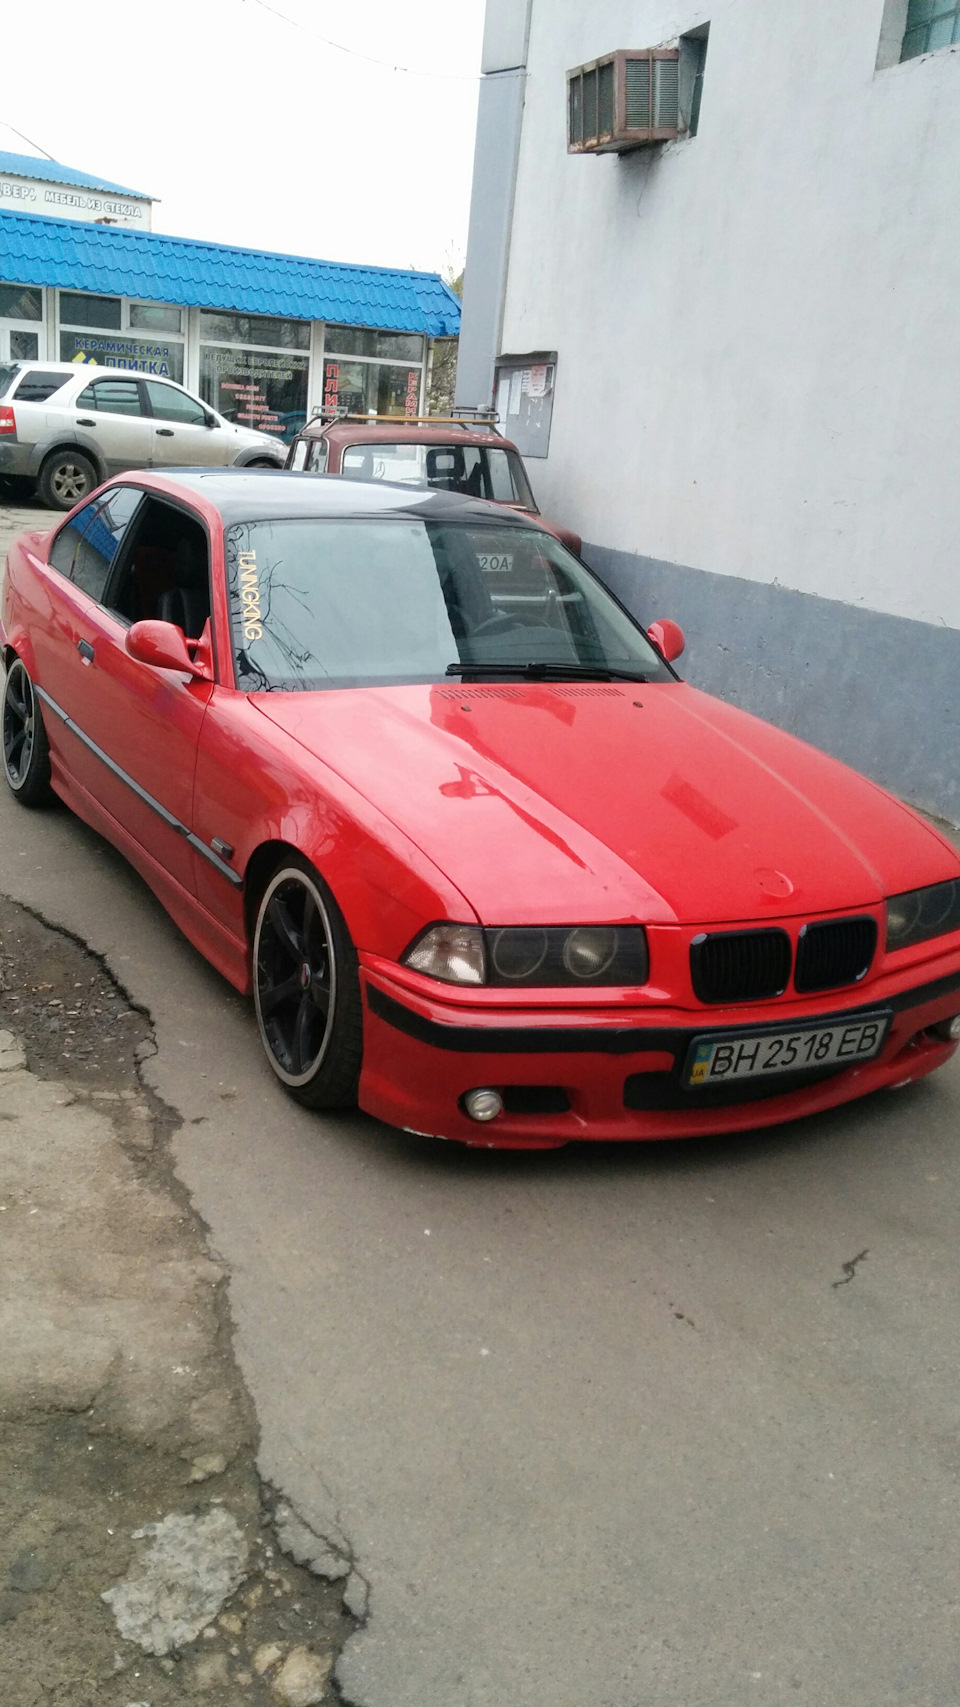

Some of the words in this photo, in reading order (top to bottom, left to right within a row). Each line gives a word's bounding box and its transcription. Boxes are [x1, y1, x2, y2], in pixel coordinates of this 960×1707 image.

[44, 190, 87, 208] МЕБЕЛЬ
[87, 198, 102, 211] ИЗ
[103, 201, 142, 218] СТЕКЛА
[74, 337, 170, 357] КЕРАМИЧЕСКАЯ
[709, 1041, 760, 1076] BH
[762, 1032, 833, 1069] 2518
[836, 1023, 879, 1057] EB
[691, 1069, 705, 1078] UA
